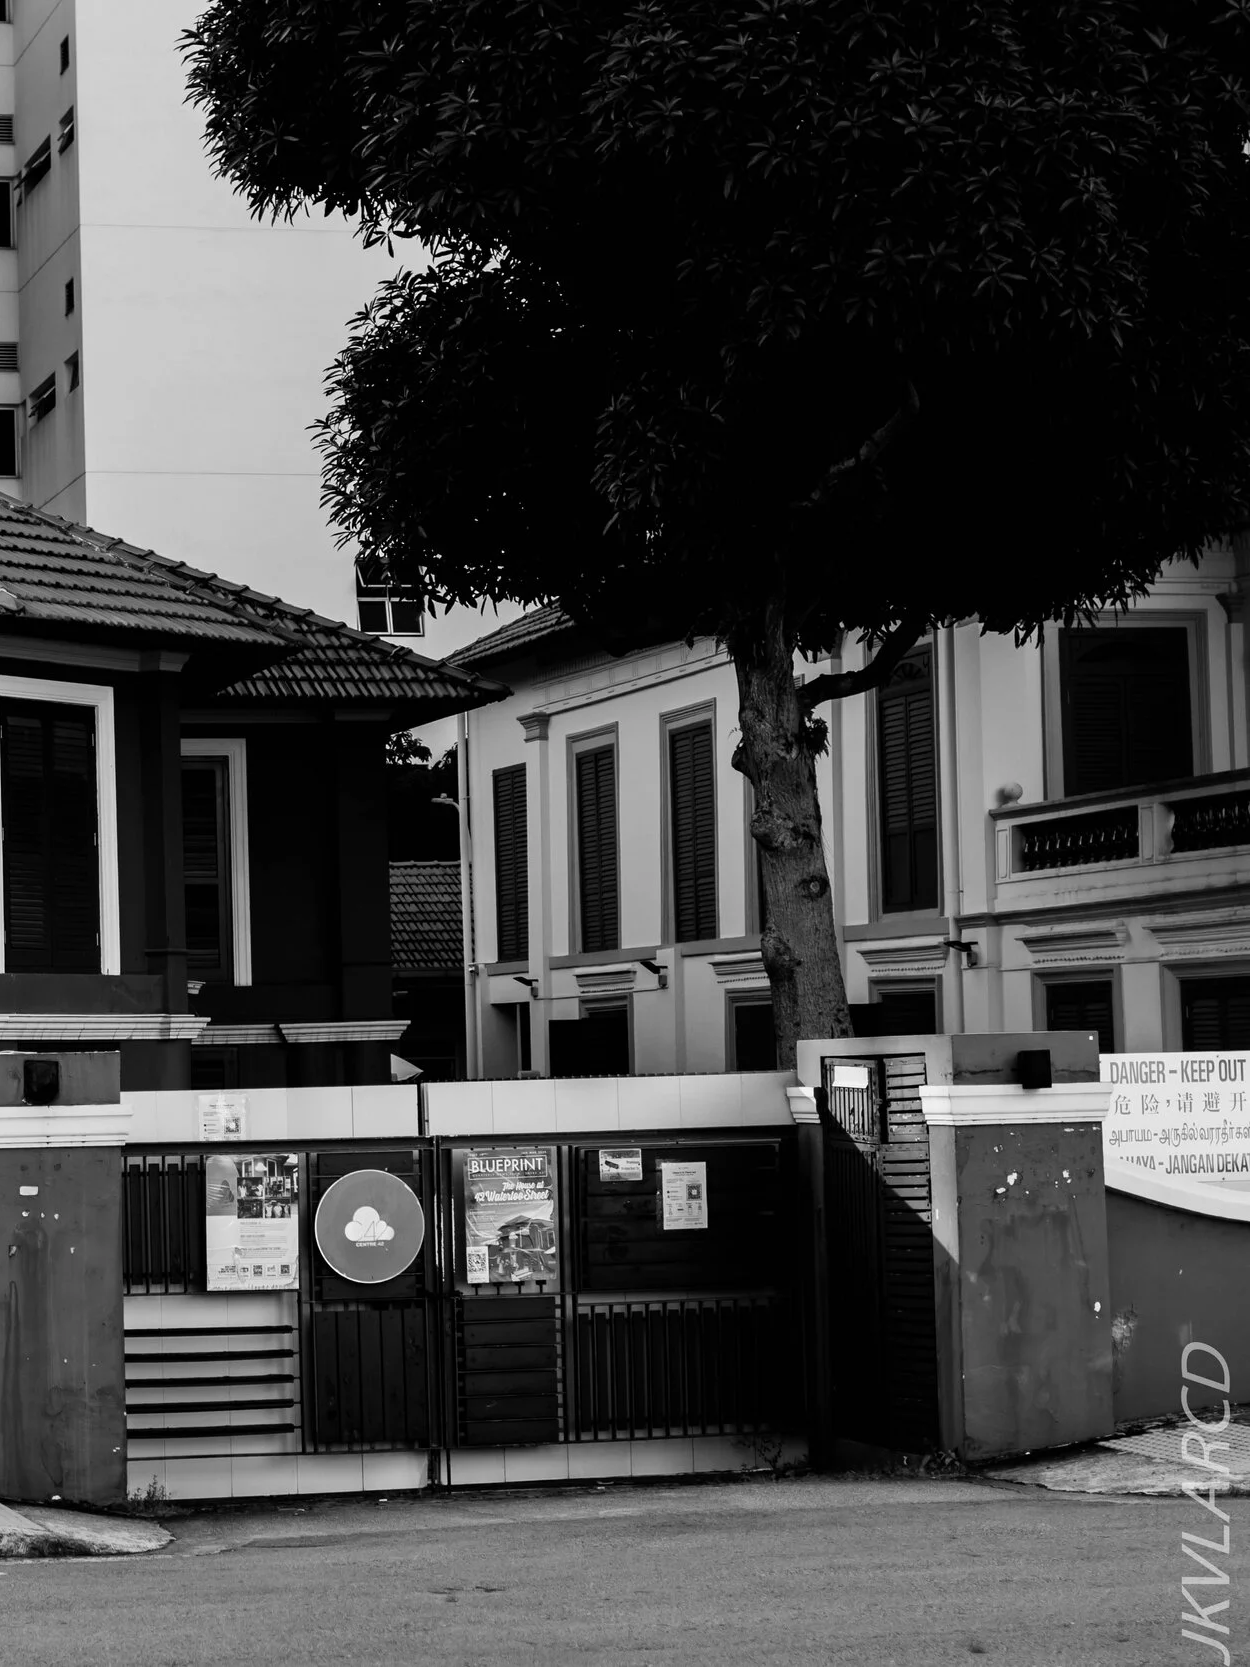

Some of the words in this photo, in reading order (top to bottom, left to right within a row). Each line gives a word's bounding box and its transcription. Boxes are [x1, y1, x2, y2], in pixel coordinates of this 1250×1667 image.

[1109, 1060, 1166, 1085] DANGER
[1180, 1059, 1215, 1083] KEEP
[1218, 1058, 1247, 1082] OUT
[471, 1157, 544, 1173] BLUEPRINT
[1165, 1153, 1215, 1174] JANGAN
[502, 1181, 516, 1191] The
[485, 1190, 524, 1202] Waterloo
[523, 1188, 549, 1200] Street
